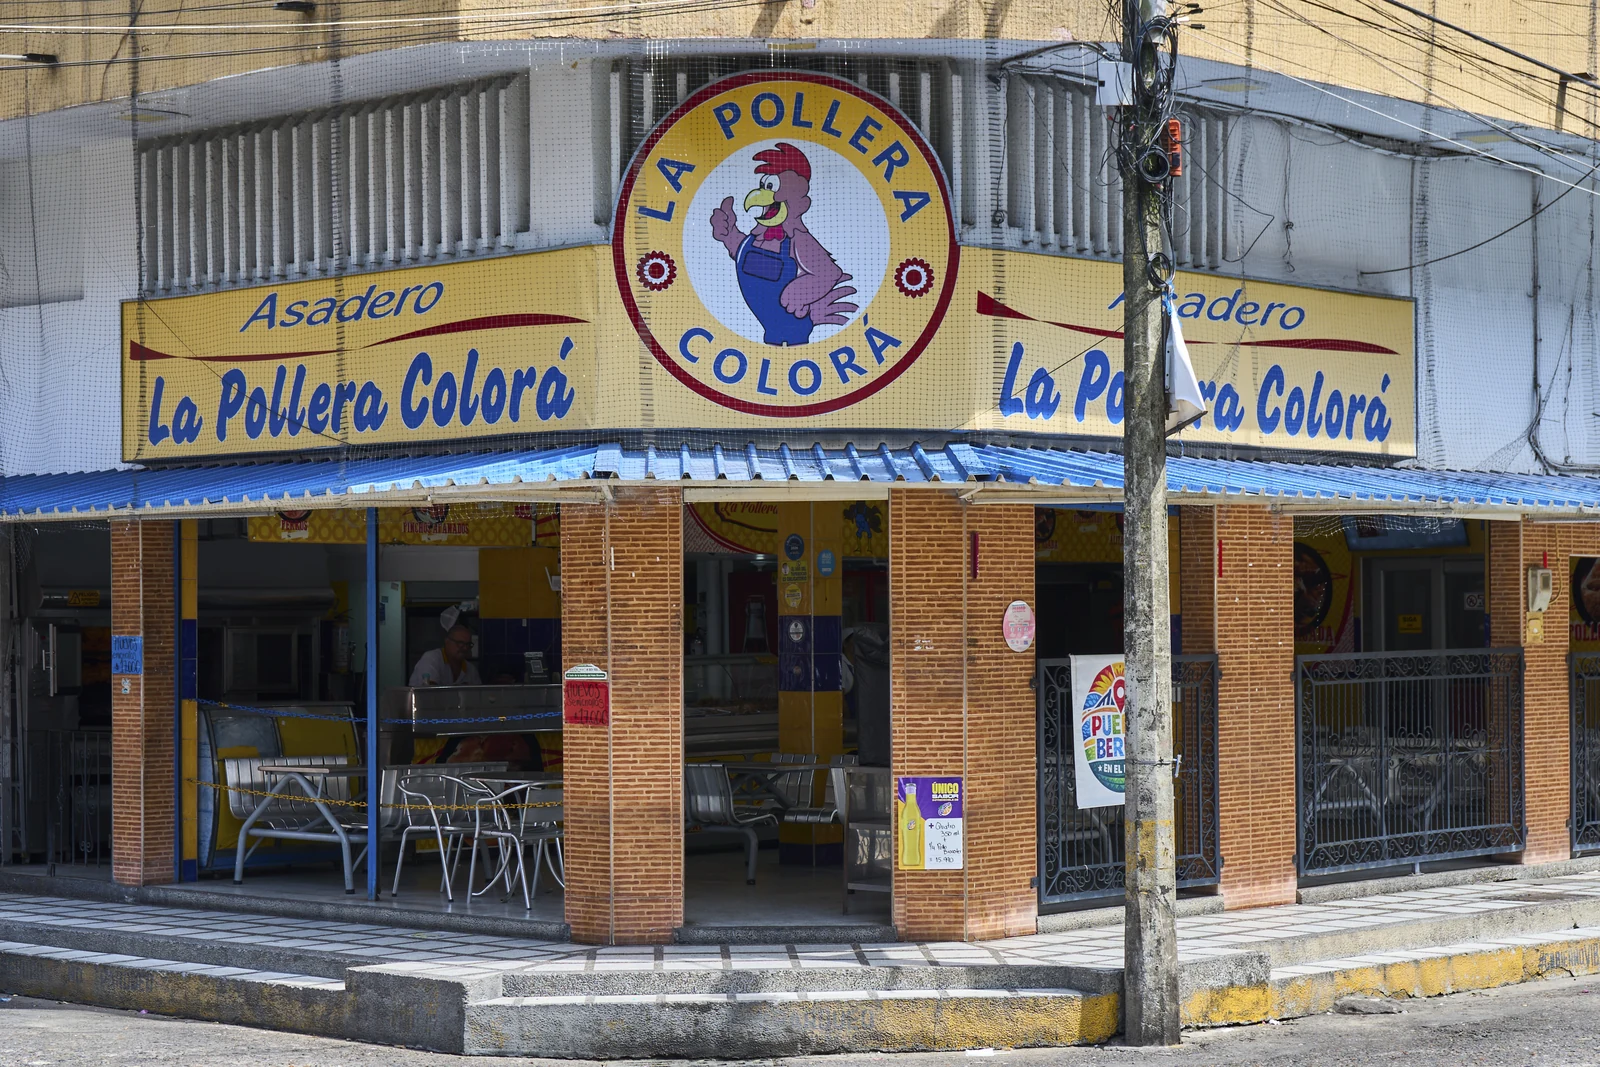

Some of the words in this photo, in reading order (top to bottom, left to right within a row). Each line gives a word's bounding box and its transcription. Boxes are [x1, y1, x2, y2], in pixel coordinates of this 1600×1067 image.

[637, 156, 696, 223] LA
[713, 91, 933, 223] POLLERA
[239, 281, 444, 333] Asadero
[1108, 287, 1305, 331] adero
[679, 313, 903, 396] COLORÁ
[148, 375, 204, 447] La
[216, 363, 388, 443] Pollera
[400, 335, 575, 430] Colorá
[998, 341, 1061, 420] La
[1257, 363, 1392, 443] Colorá
[565, 681, 601, 700] HUEVOS
[932, 781, 959, 794] ÚNICO
[1103, 762, 1113, 774] EN
[1113, 763, 1123, 774] EL
